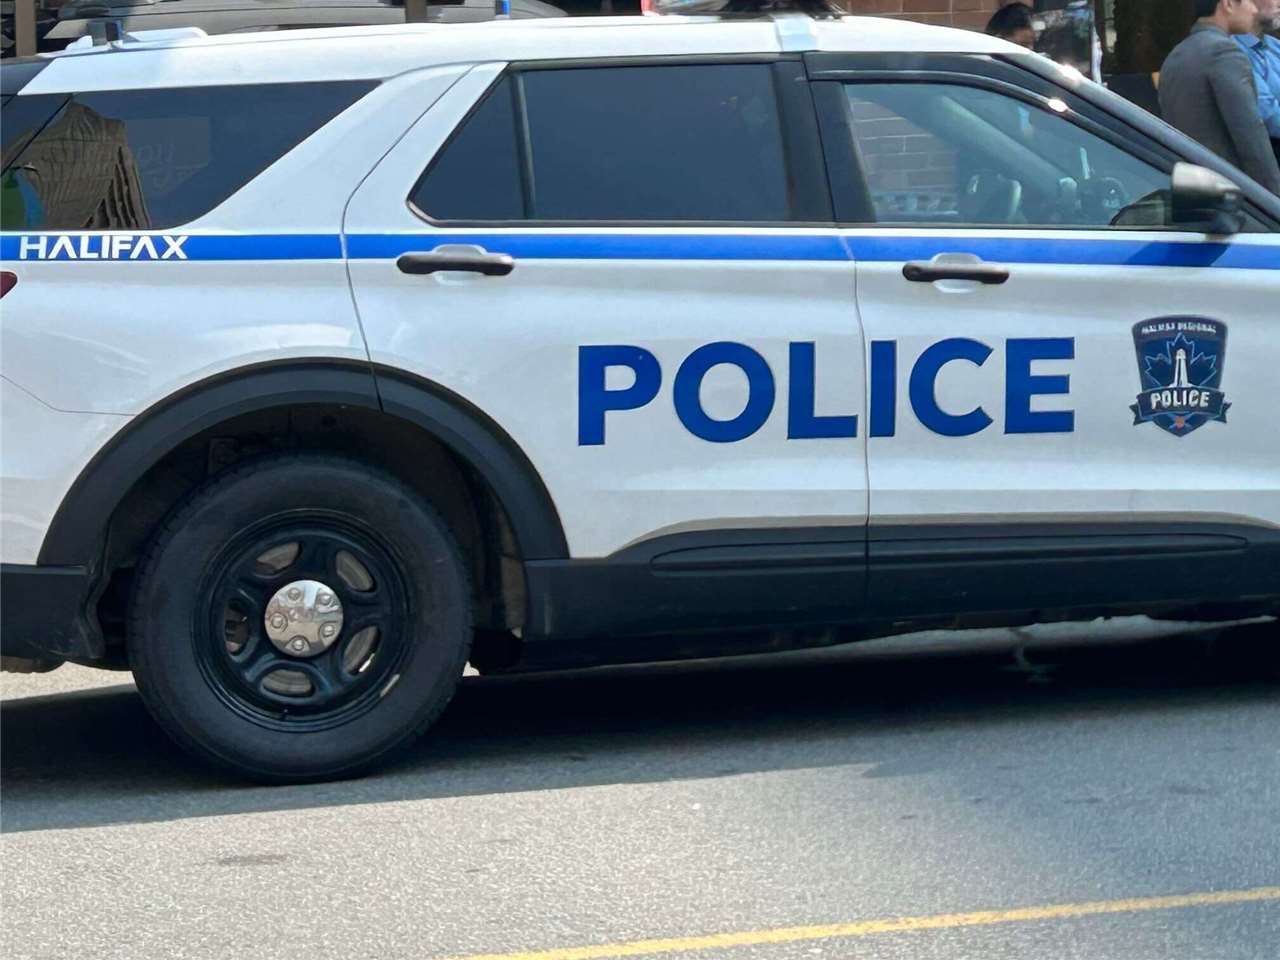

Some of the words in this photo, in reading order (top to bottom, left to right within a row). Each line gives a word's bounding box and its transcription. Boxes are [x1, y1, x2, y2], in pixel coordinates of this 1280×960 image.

[20, 234, 189, 260] HALIFAX
[578, 336, 1076, 445] POLICE
[1150, 389, 1211, 410] POLICE
